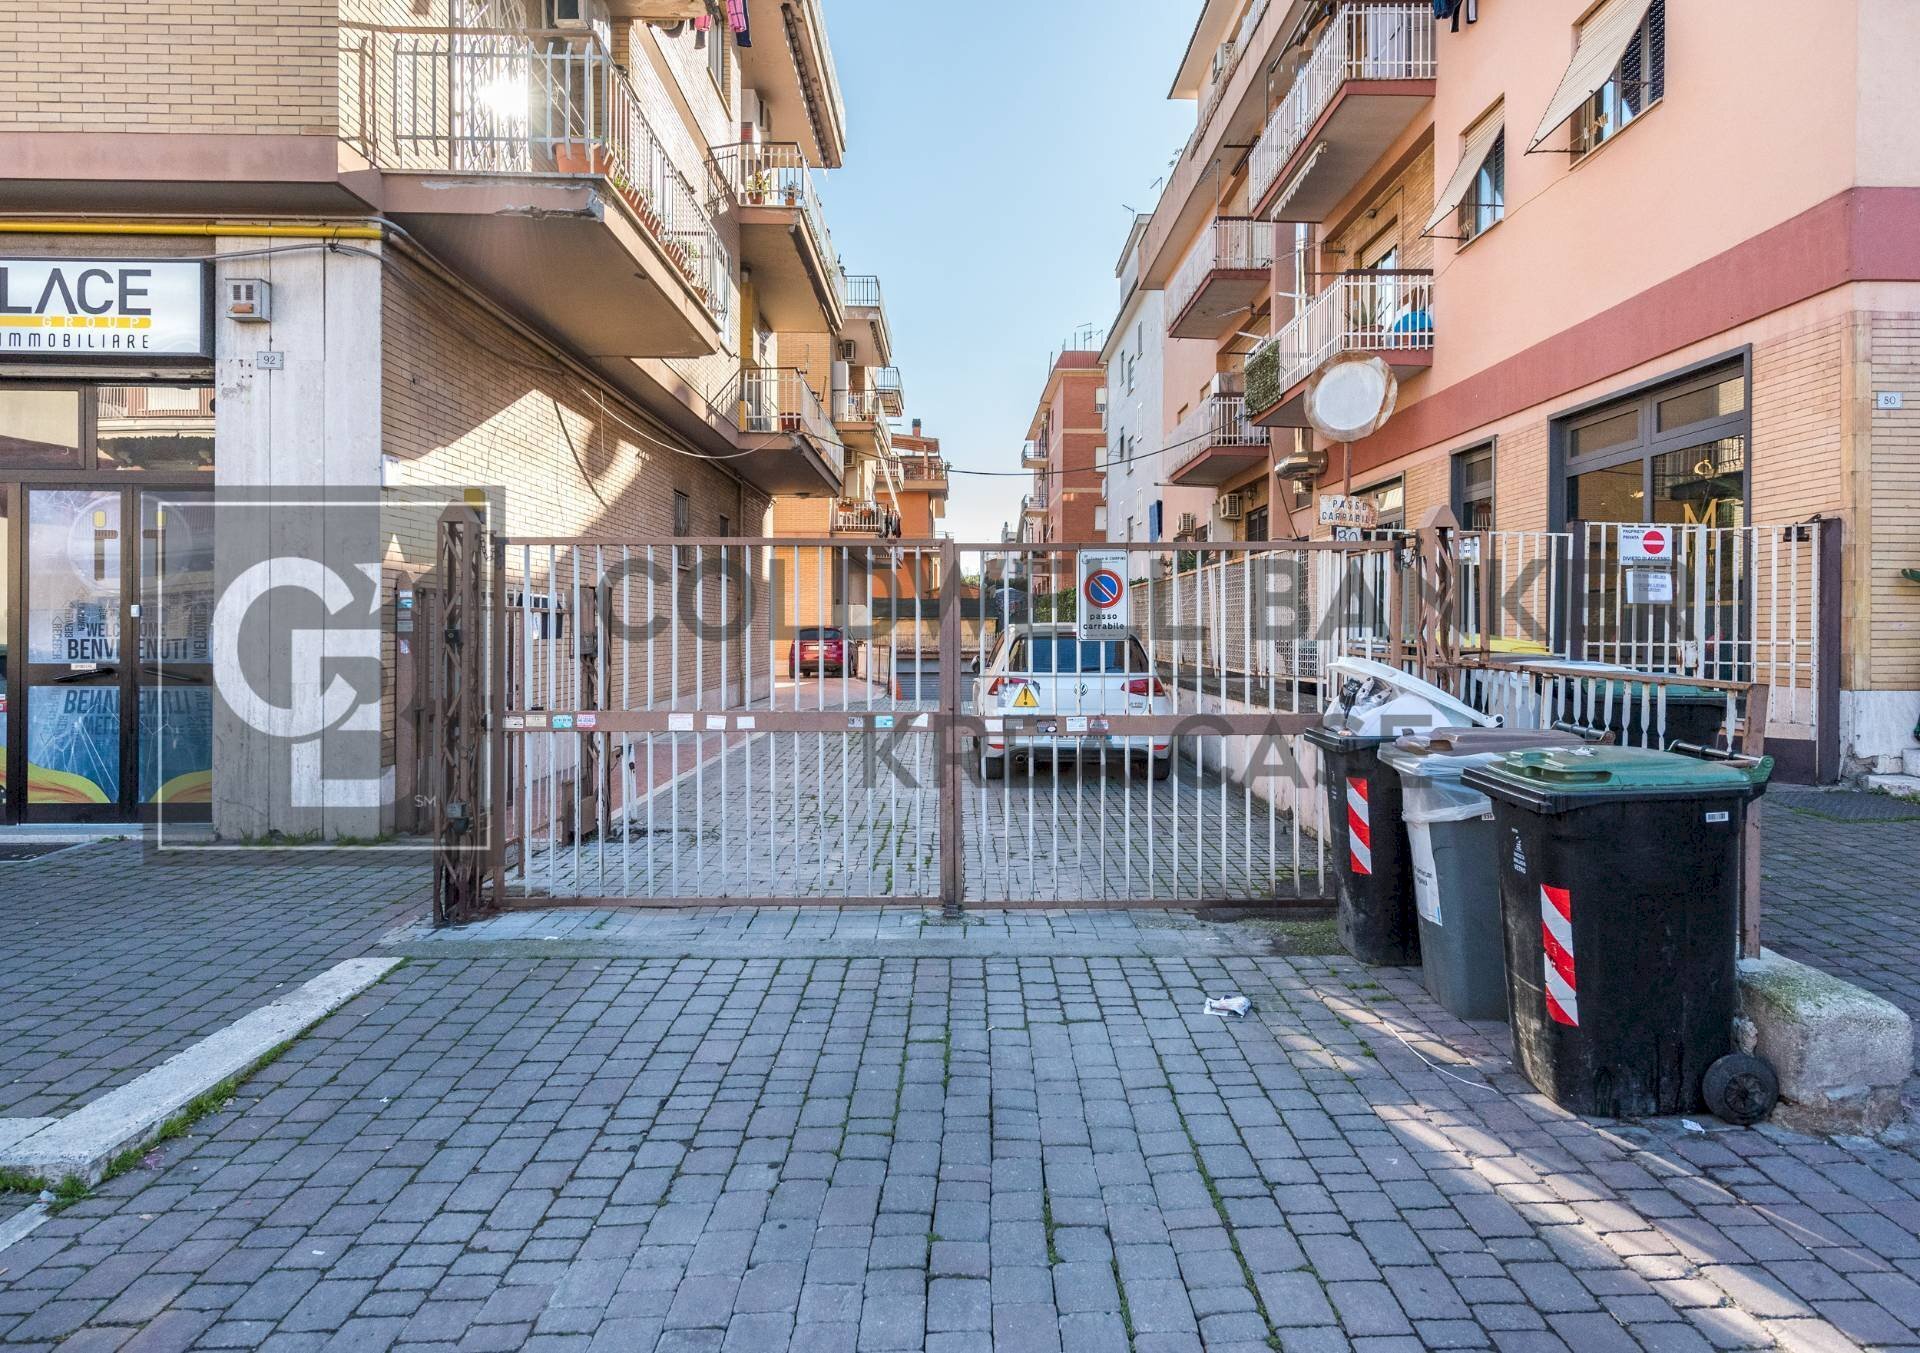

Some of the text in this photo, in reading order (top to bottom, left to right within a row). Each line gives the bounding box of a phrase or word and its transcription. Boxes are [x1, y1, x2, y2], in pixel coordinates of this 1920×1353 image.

[0, 267, 152, 315] LACE
[42, 316, 140, 328] GROUP
[263, 355, 276, 365] 92
[1089, 613, 1118, 621] passo
[1082, 622, 1125, 630] carrabile
